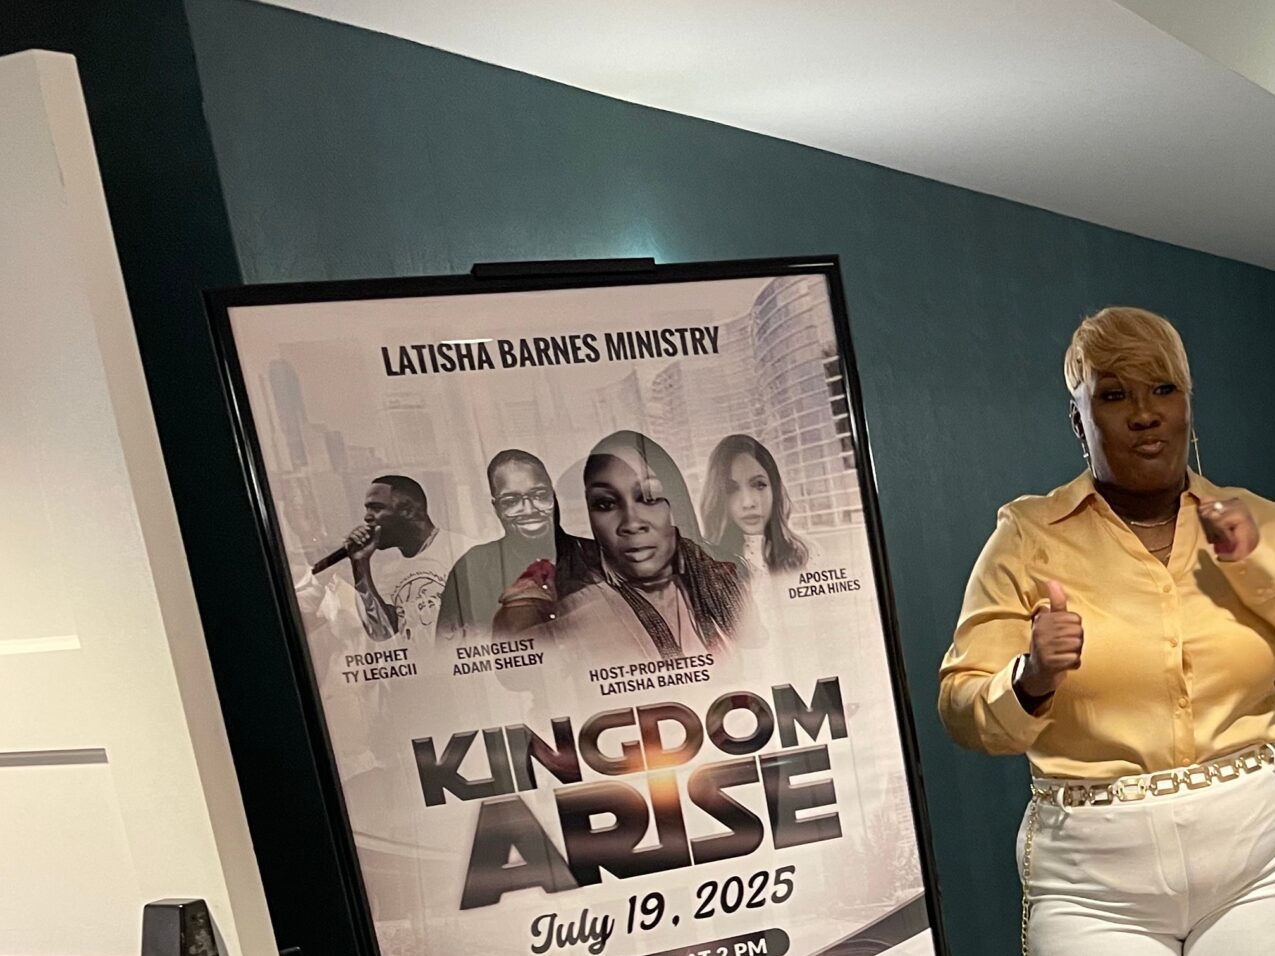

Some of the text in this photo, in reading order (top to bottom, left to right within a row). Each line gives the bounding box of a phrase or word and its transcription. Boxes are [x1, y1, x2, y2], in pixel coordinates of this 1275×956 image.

[381, 326, 719, 376] LATISHA BARNES MINISTRY
[799, 568, 847, 584] APOSTLE
[789, 579, 861, 599] DEZRA HINES
[345, 648, 409, 667] PROPHET
[456, 638, 536, 660] EVANGELIST
[342, 663, 418, 684] TY LEGACII
[453, 652, 544, 676] ADAM SHELBY
[589, 653, 714, 682] HOST-PROPHETESS
[600, 669, 711, 696] LATISHA BARNES
[411, 676, 849, 807] KINGDOM
[459, 744, 843, 910] ARISE
[530, 908, 615, 955] July
[694, 865, 796, 920] 2025
